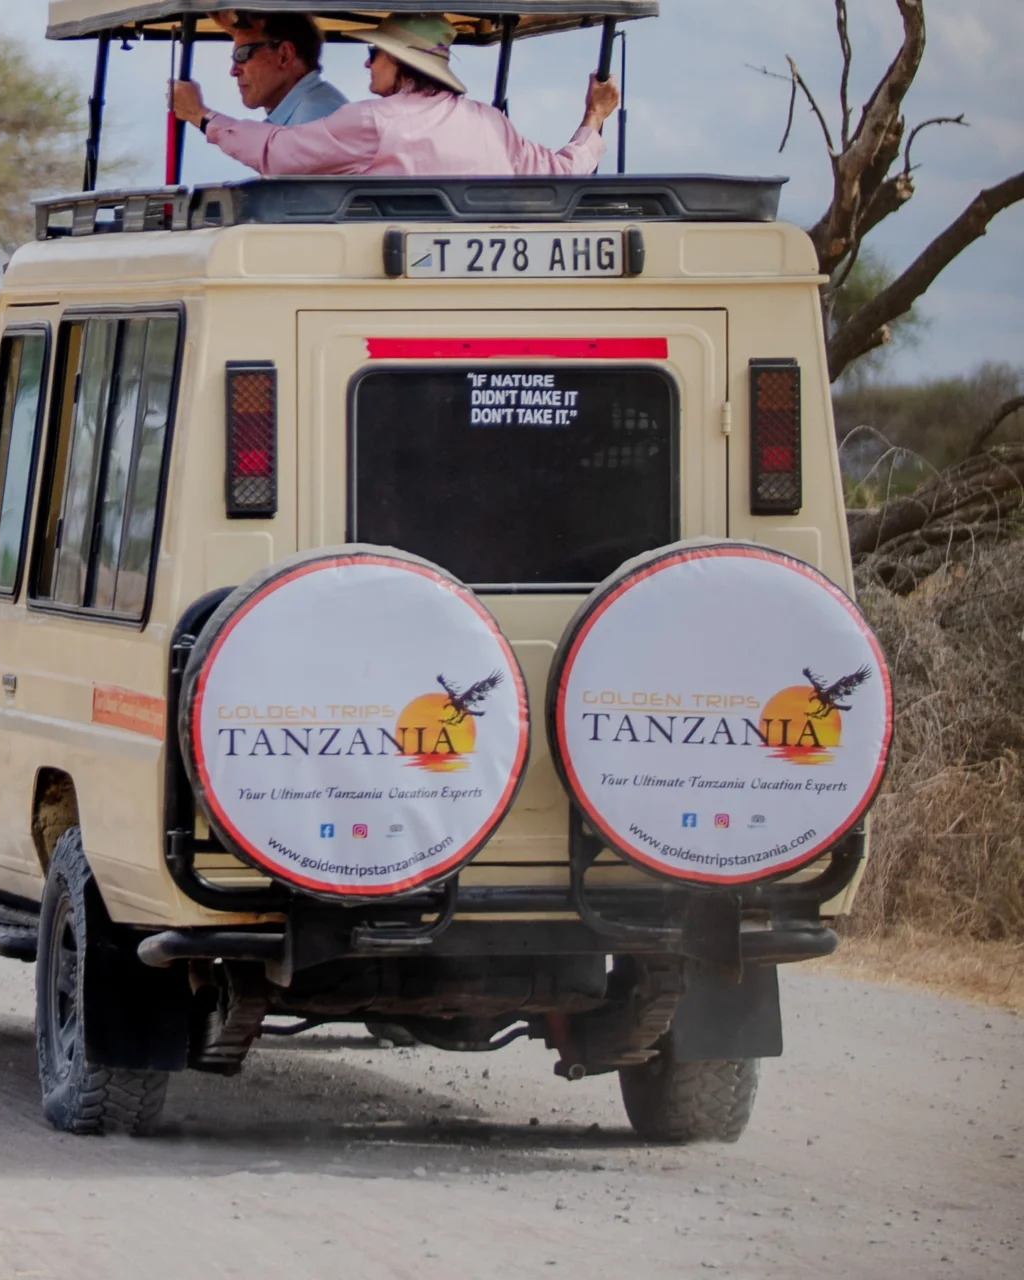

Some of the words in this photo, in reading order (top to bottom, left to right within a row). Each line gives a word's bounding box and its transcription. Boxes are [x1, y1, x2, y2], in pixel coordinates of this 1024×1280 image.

[433, 239, 451, 272] T
[466, 238, 529, 272] 278
[549, 237, 615, 271] AHG
[490, 374, 555, 387] NATURE
[520, 390, 562, 406] MAKE
[564, 391, 578, 406] IT
[516, 409, 553, 425] TAKE
[582, 690, 682, 708] GOLDEN
[692, 694, 761, 709] TRIPS
[217, 705, 317, 720] GOLDEN
[327, 705, 396, 719] TRIPS
[582, 713, 824, 748] TANZANIA
[218, 727, 458, 757] TANZANIA
[238, 788, 267, 801] Your
[271, 787, 322, 800] Ultimate
[325, 786, 383, 800] Tanzania
[440, 786, 483, 802] Experts
[600, 773, 629, 786] Your
[632, 774, 685, 788] Ultimate
[688, 776, 746, 789] Tanzania
[805, 778, 848, 795] Experts
[628, 823, 817, 868] www.goldentripstanzania.com
[267, 834, 454, 878] www.goldentripstanzania.com
